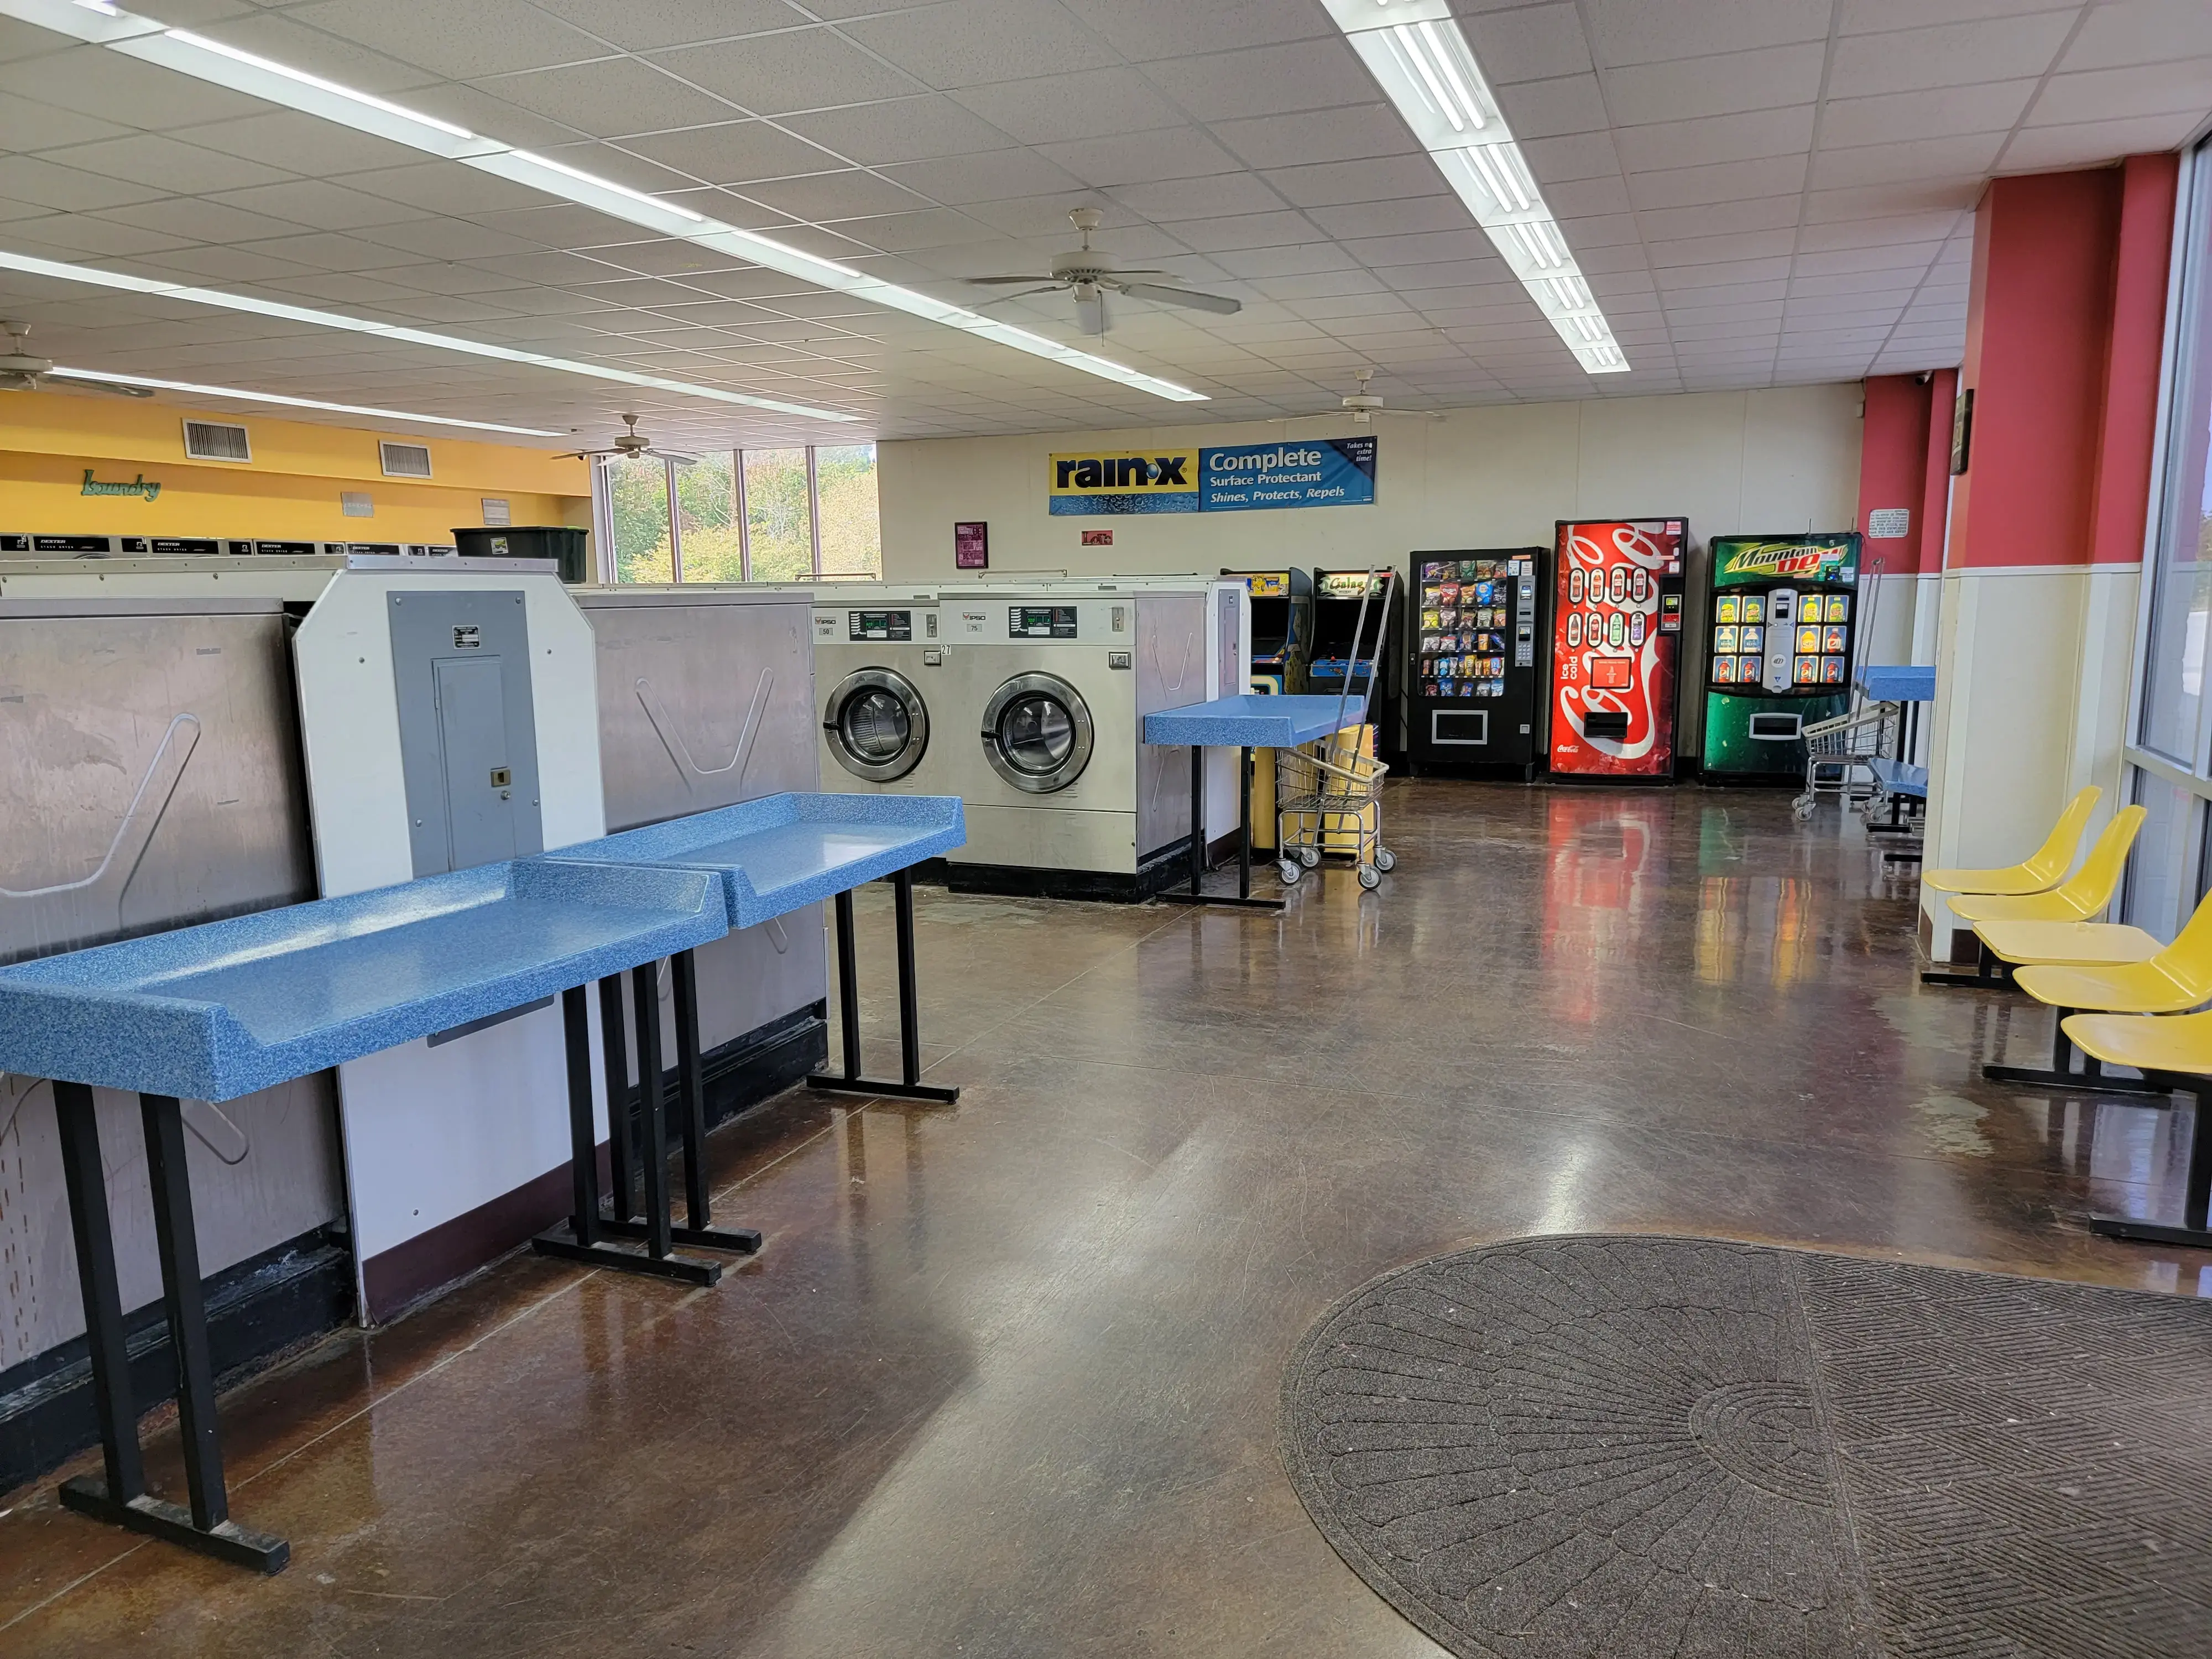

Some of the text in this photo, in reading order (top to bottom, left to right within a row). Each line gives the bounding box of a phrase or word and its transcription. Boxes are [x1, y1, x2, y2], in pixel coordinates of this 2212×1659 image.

[1209, 447, 1322, 473] Complete
[1210, 471, 1322, 487] Surface Protectant
[1210, 492, 1248, 503] Shines,
[1253, 490, 1302, 501] Protects,
[1306, 486, 1345, 499] Repels
[1734, 546, 1818, 571] Mountain
[1329, 576, 1372, 595] Galag
[941, 645, 950, 654] 27
[1560, 663, 1569, 680] Ice
[1569, 656, 1578, 680] cold
